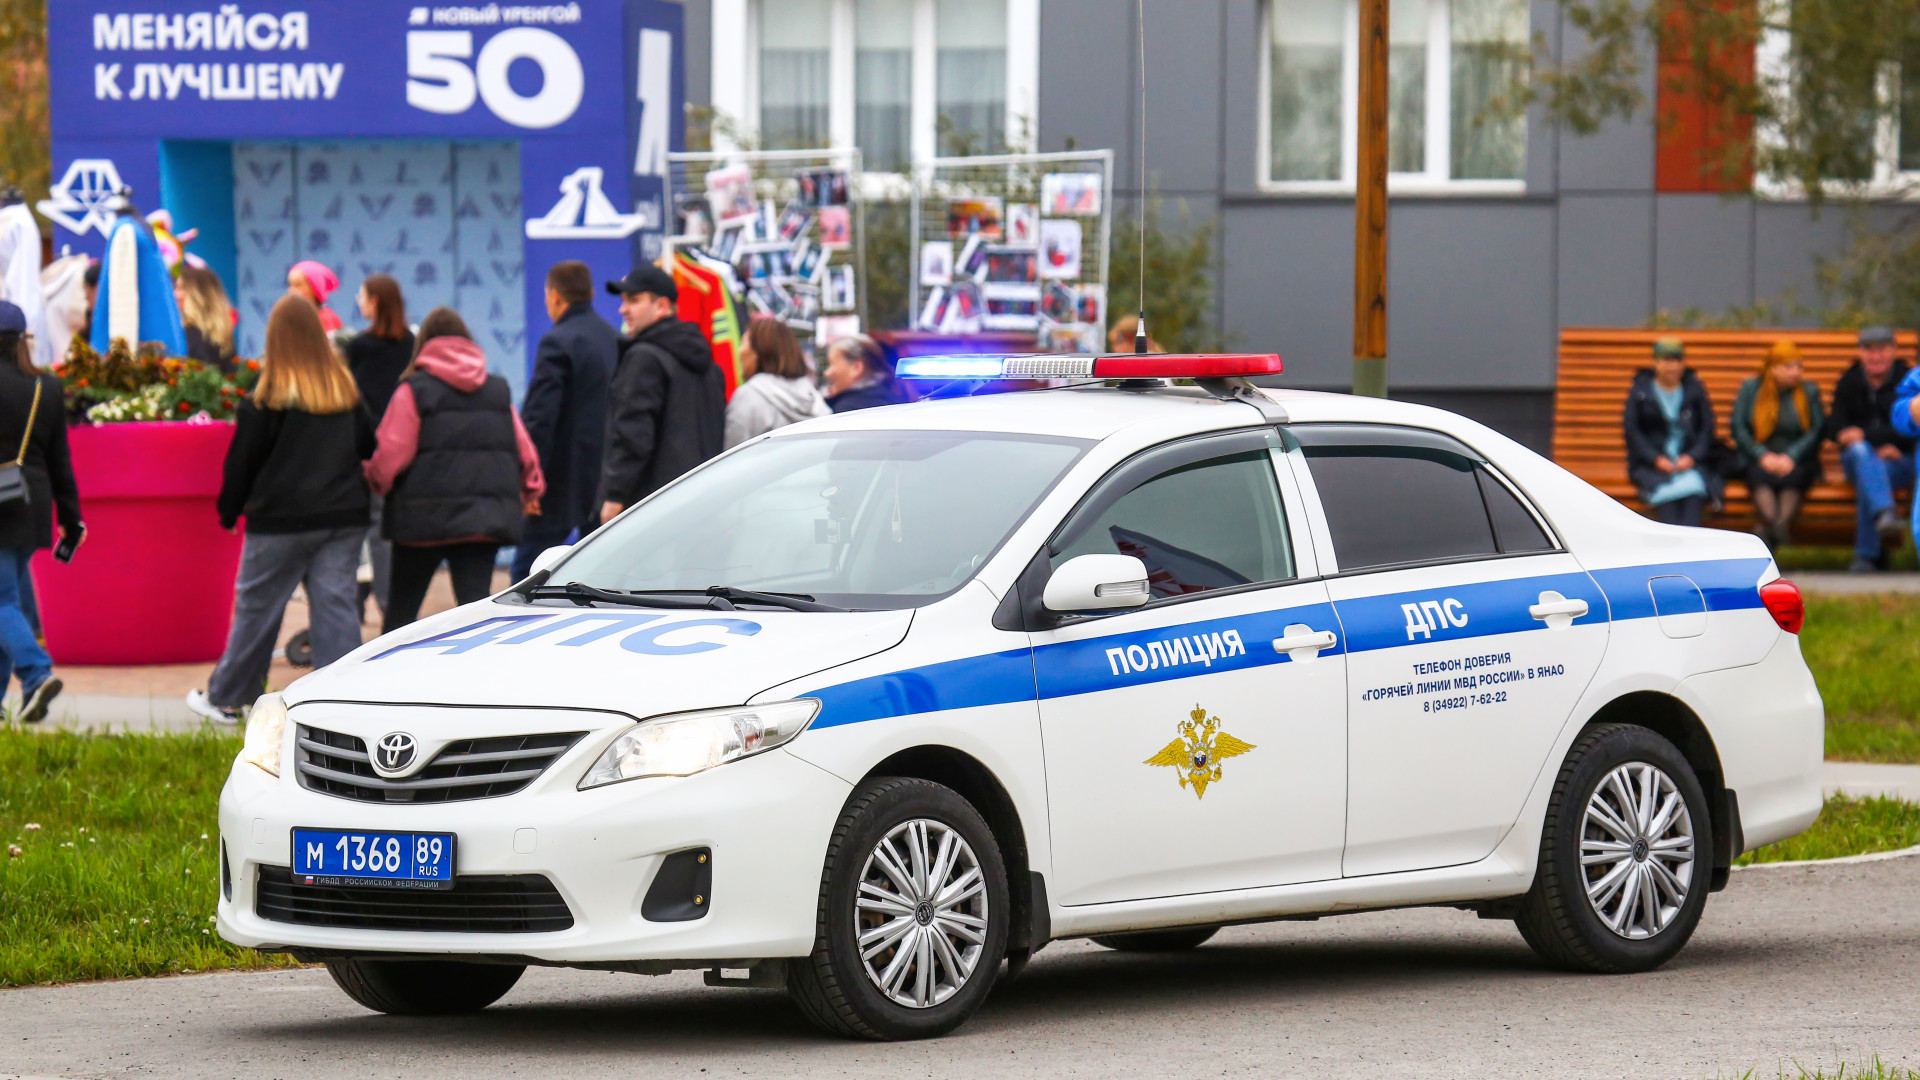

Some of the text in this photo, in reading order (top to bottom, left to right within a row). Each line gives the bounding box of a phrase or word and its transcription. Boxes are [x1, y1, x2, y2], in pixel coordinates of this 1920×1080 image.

[93, 4, 308, 50] МЕНЯЙСЯ
[432, 1, 582, 25] НОВЫЙ УРЕНГОЙ
[95, 63, 344, 100] К ЛУЧШЕМУ
[406, 26, 585, 129] 50
[362, 613, 762, 663] ДПС
[1400, 598, 1469, 641] ДПС
[1105, 629, 1246, 675] ПОЛИЦИЯ
[1413, 652, 1511, 676] ТЕЛЕФОН ДОВЕРИЯ
[1362, 664, 1565, 701] «ГОРЯЧЕЙ ЛИНИИ МВД РОССИИ» В ЯНАО
[1423, 691, 1507, 714] 8 (34922) 7-62-22
[306, 835, 401, 873] М 1368
[416, 837, 443, 865] 89
[418, 865, 438, 877] RUS
